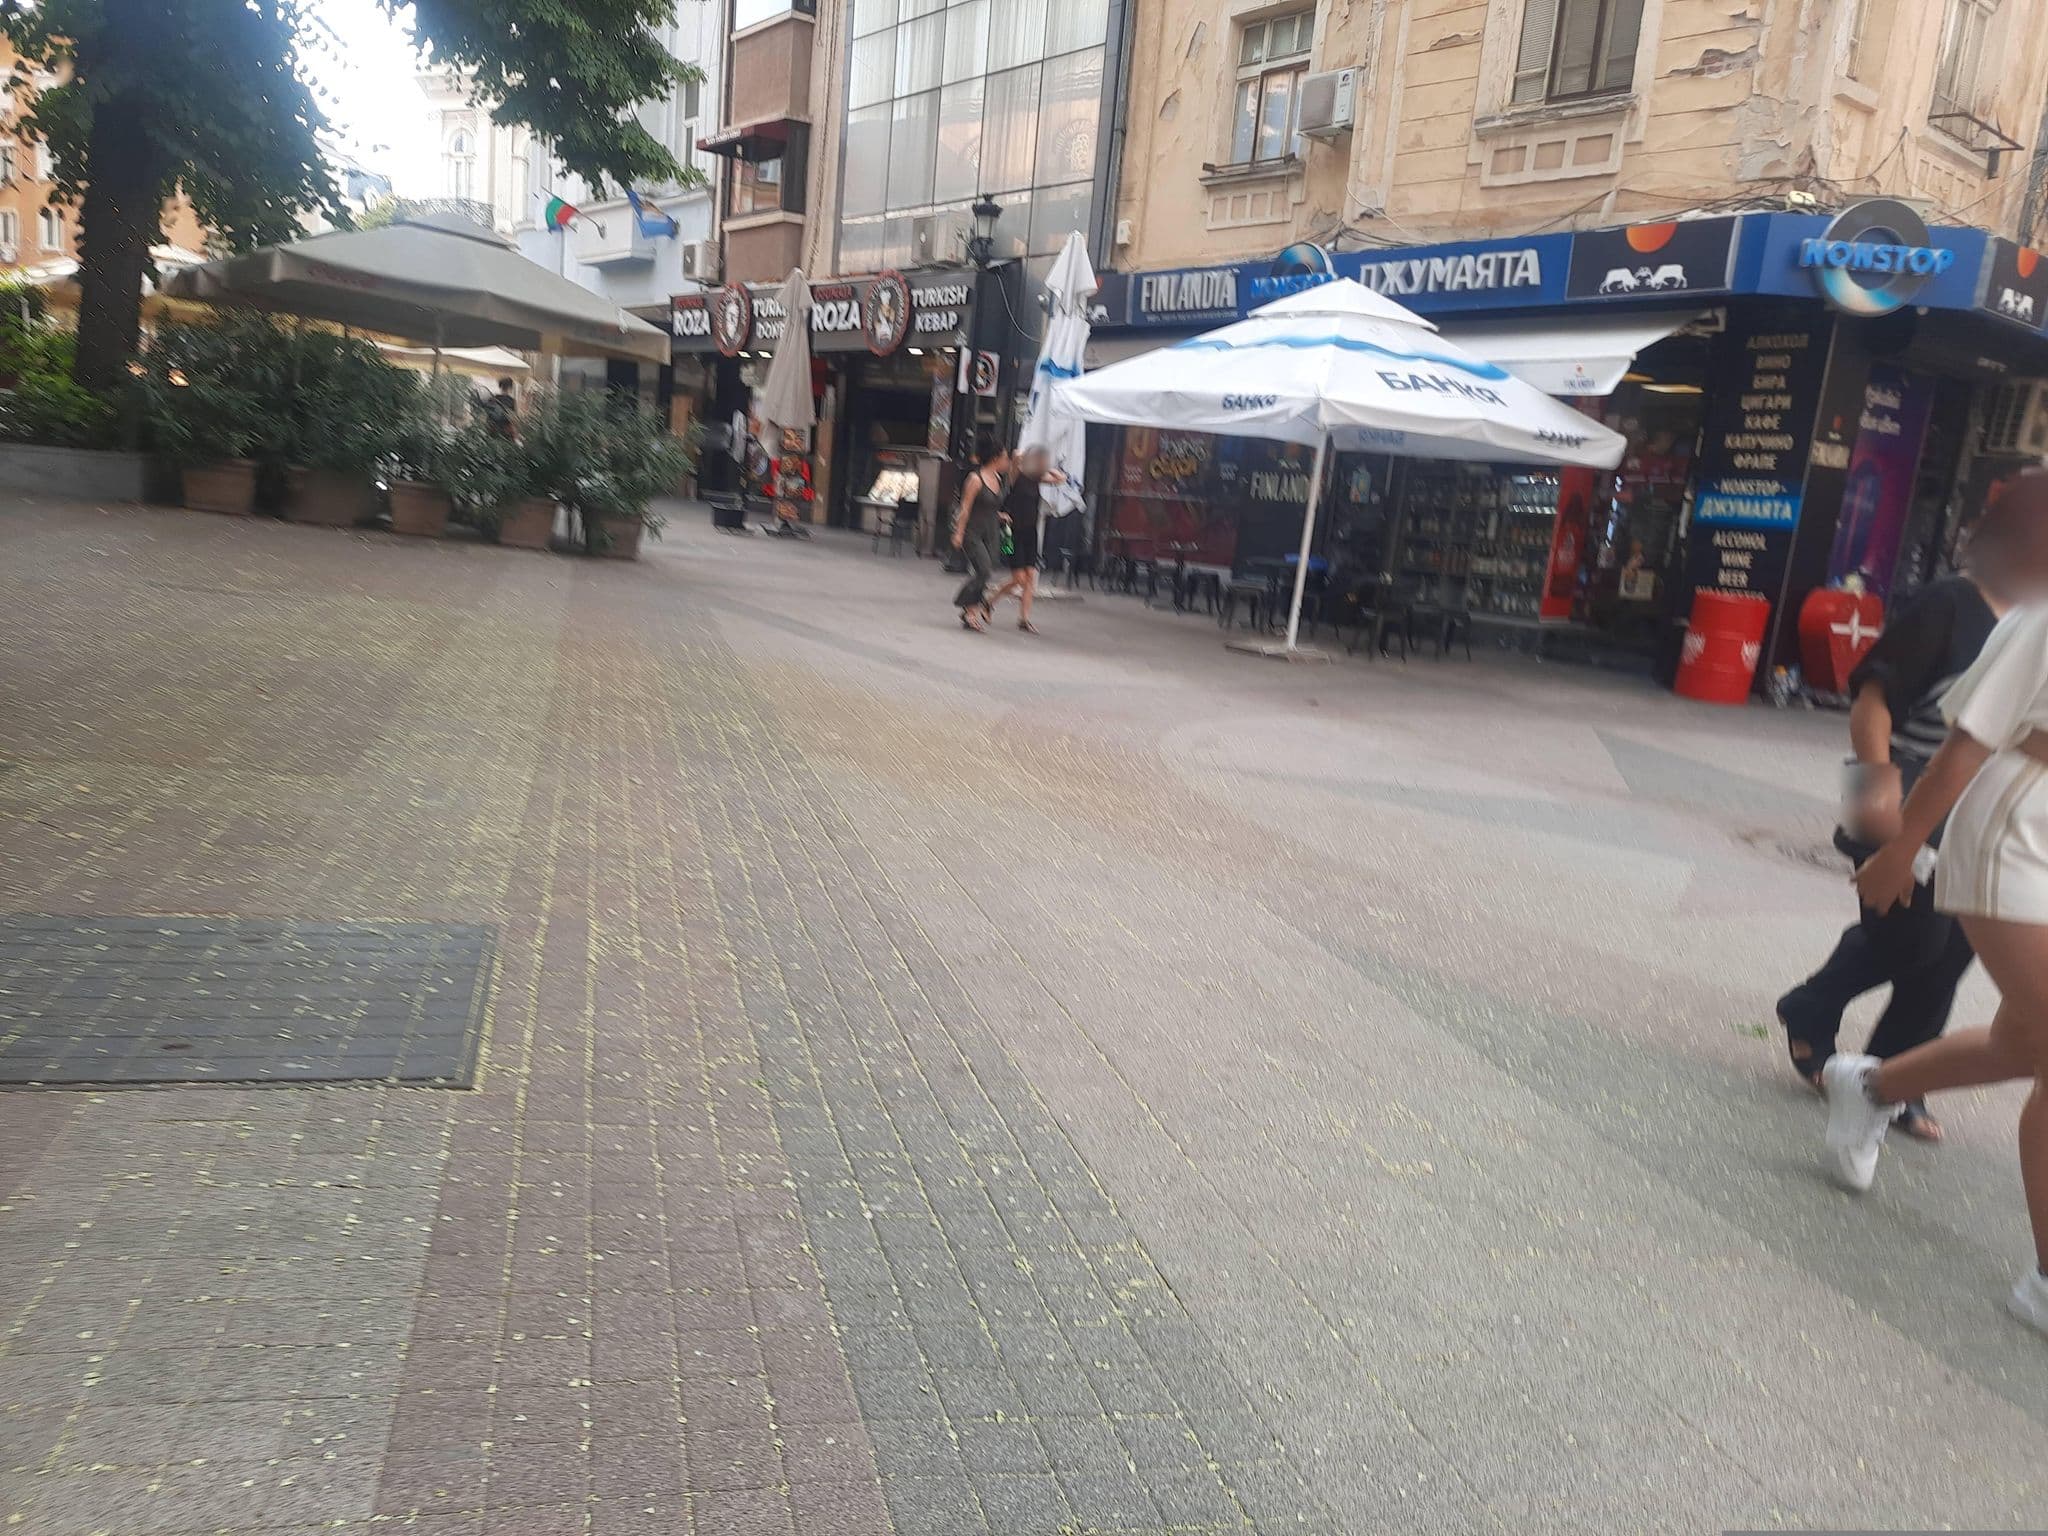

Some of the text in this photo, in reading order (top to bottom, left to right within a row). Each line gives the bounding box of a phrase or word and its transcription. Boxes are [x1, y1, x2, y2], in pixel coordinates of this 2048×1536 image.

[1802, 238, 1956, 275] NONSTOP
[911, 285, 968, 308] TURKISH
[1140, 270, 1238, 313] FINLANDIA
[672, 308, 712, 336] ROZA
[811, 300, 862, 332] ROZA
